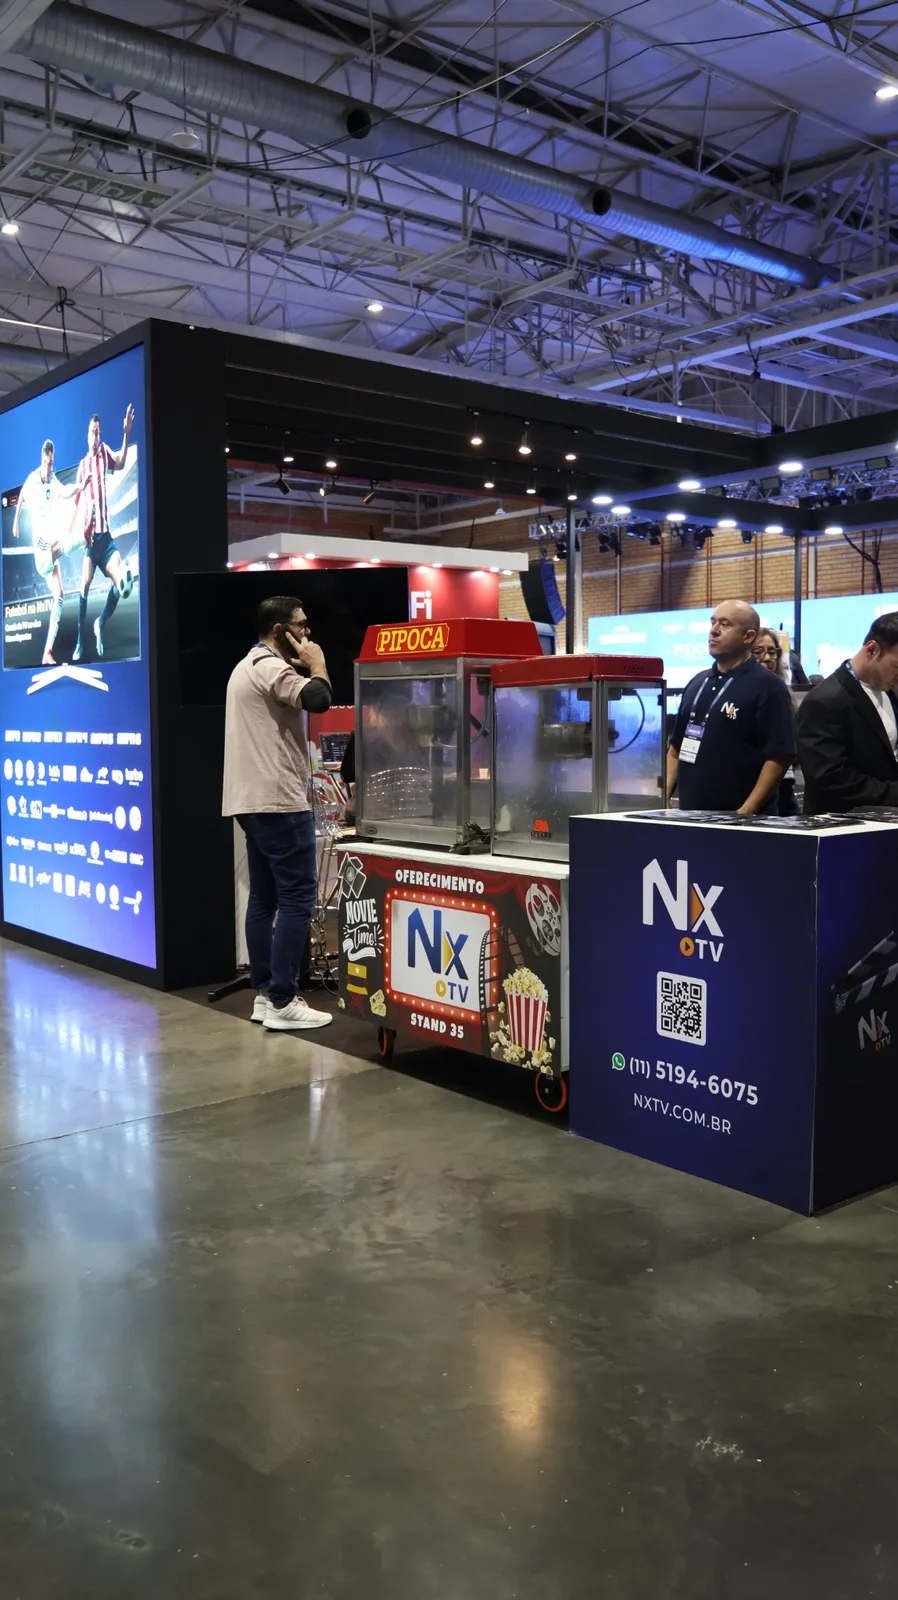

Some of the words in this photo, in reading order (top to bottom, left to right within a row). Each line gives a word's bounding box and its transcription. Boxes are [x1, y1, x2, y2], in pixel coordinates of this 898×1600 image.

[378, 626, 445, 652] PIPOCA
[395, 869, 485, 895] OFERECIMENTO
[345, 898, 378, 924] MOVIE
[642, 858, 724, 938] Nx
[347, 923, 377, 949] Time!
[407, 907, 469, 980] Nx
[695, 938, 724, 963] TV
[447, 981, 469, 1003] TV
[410, 1012, 447, 1034] STAND
[450, 1022, 464, 1039] 35
[629, 1056, 651, 1079] (11)
[655, 1060, 759, 1106] 5194-6075
[633, 1093, 732, 1135] NXTV.COM.BR
